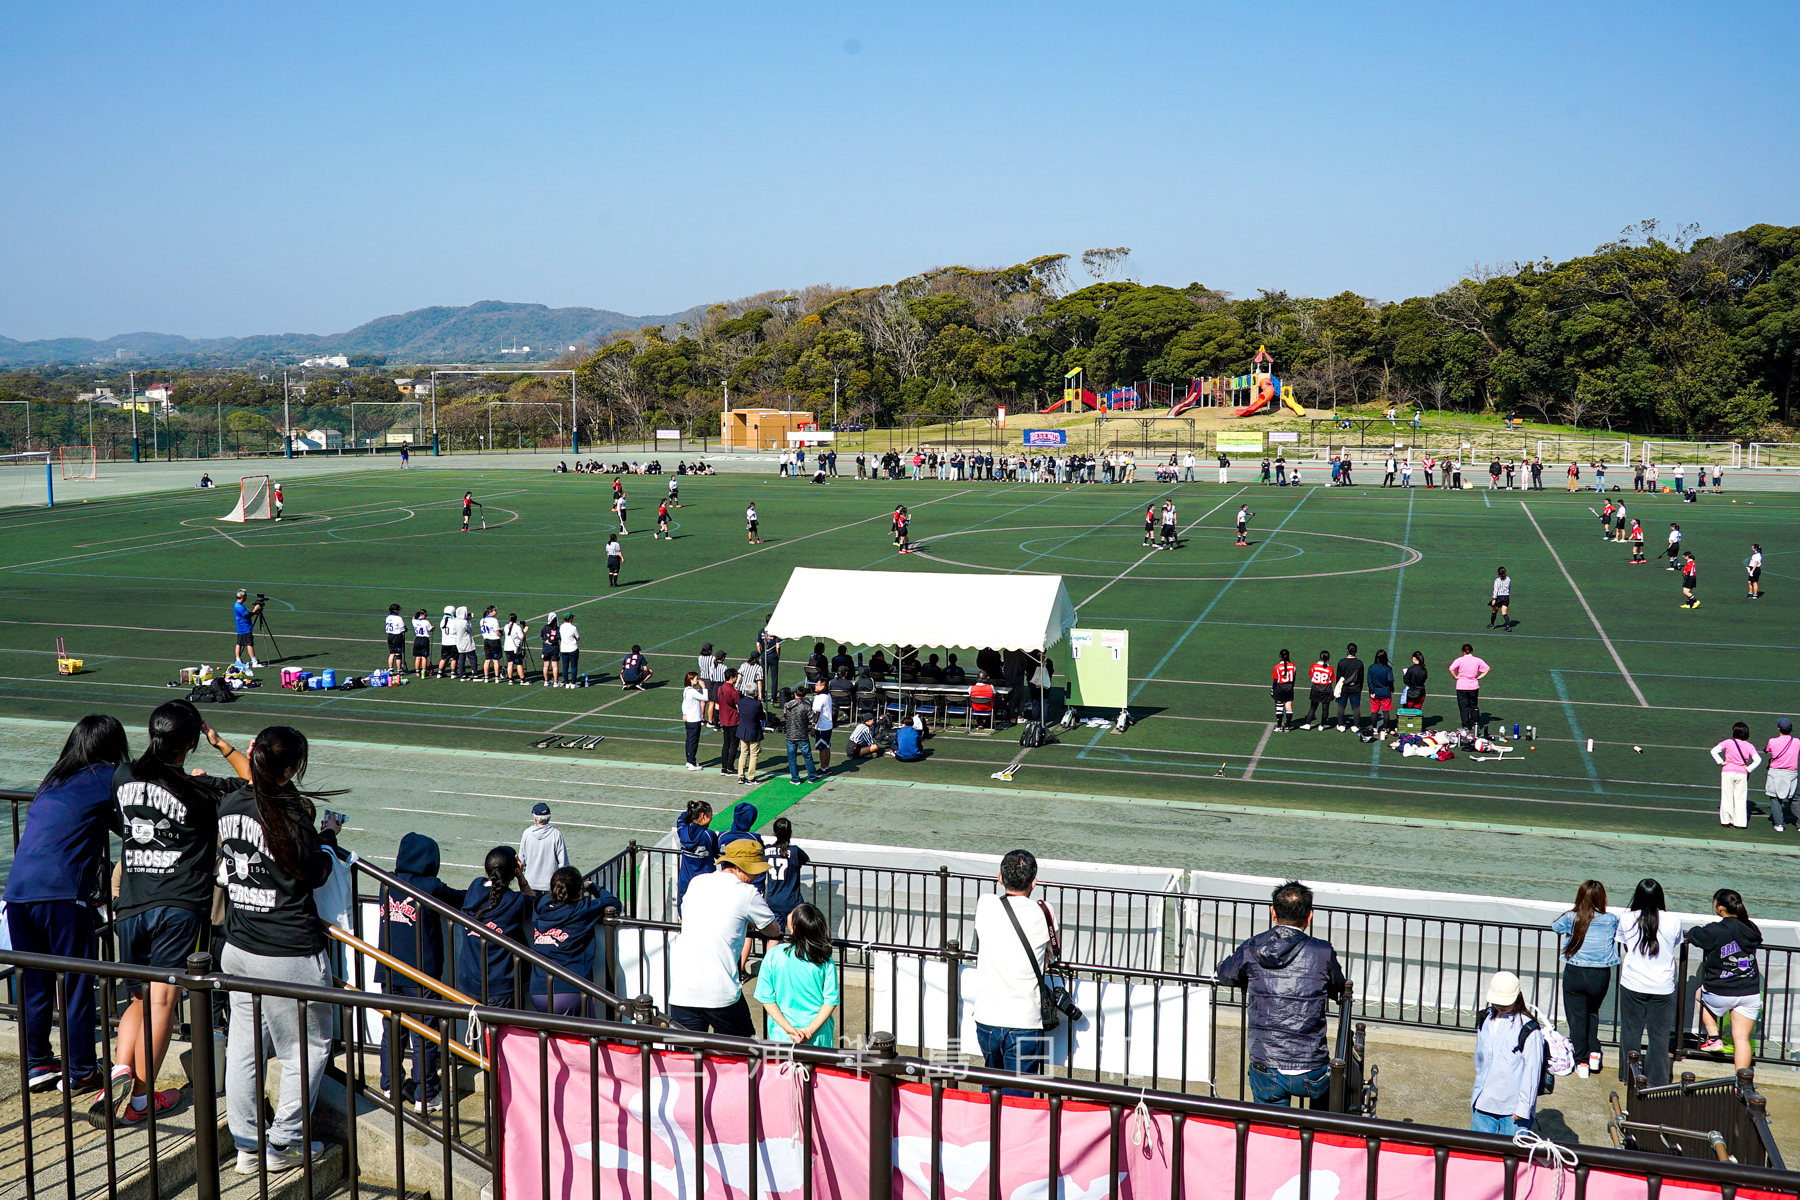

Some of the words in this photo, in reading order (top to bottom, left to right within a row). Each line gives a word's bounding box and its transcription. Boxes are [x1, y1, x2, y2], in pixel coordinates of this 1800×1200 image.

[1074, 646, 1078, 658] 1
[1113, 648, 1118, 660] 1
[145, 782, 188, 825] YOUTH
[768, 858, 788, 881] 47
